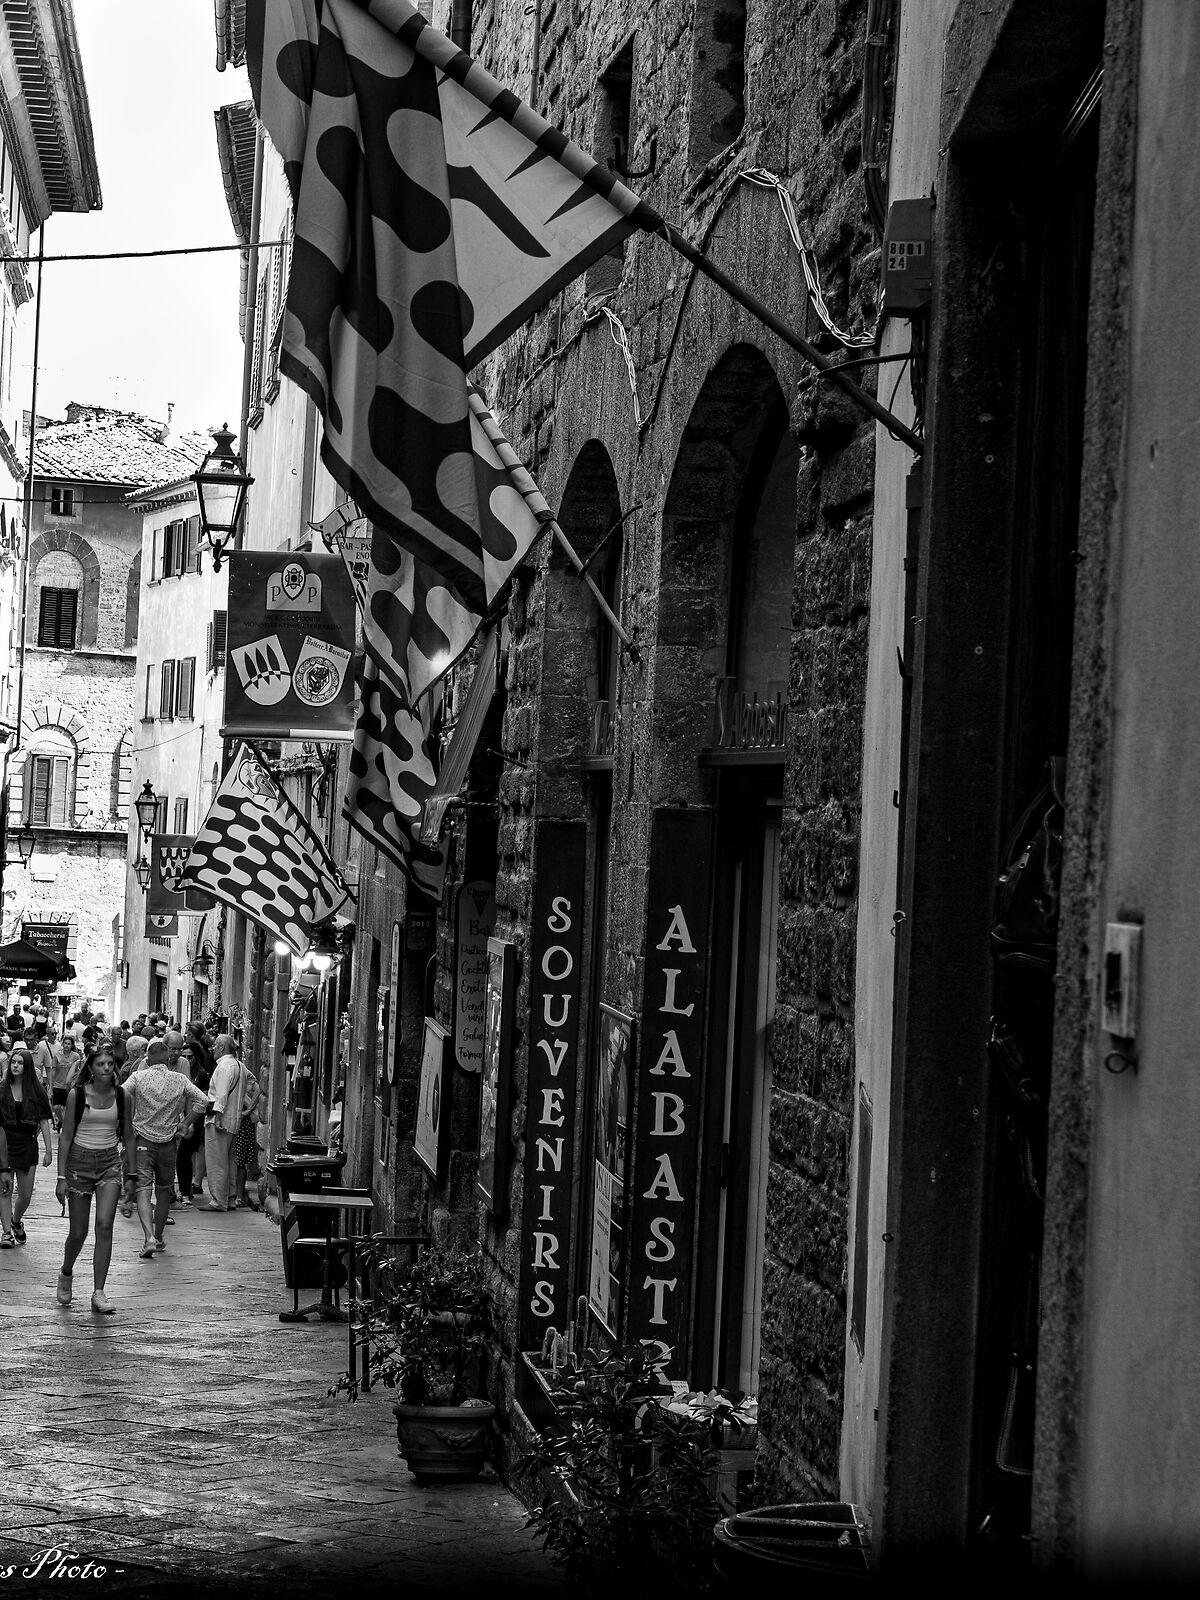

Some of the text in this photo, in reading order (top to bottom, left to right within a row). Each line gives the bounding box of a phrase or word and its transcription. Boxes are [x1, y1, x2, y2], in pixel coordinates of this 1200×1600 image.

[889, 257, 905, 269] 24
[340, 542, 354, 551] BAR
[356, 551, 370, 560] ENO
[270, 586, 318, 603] P P
[28, 930, 66, 939] Tabaccheria
[530, 895, 573, 1318] SOUVENIRS
